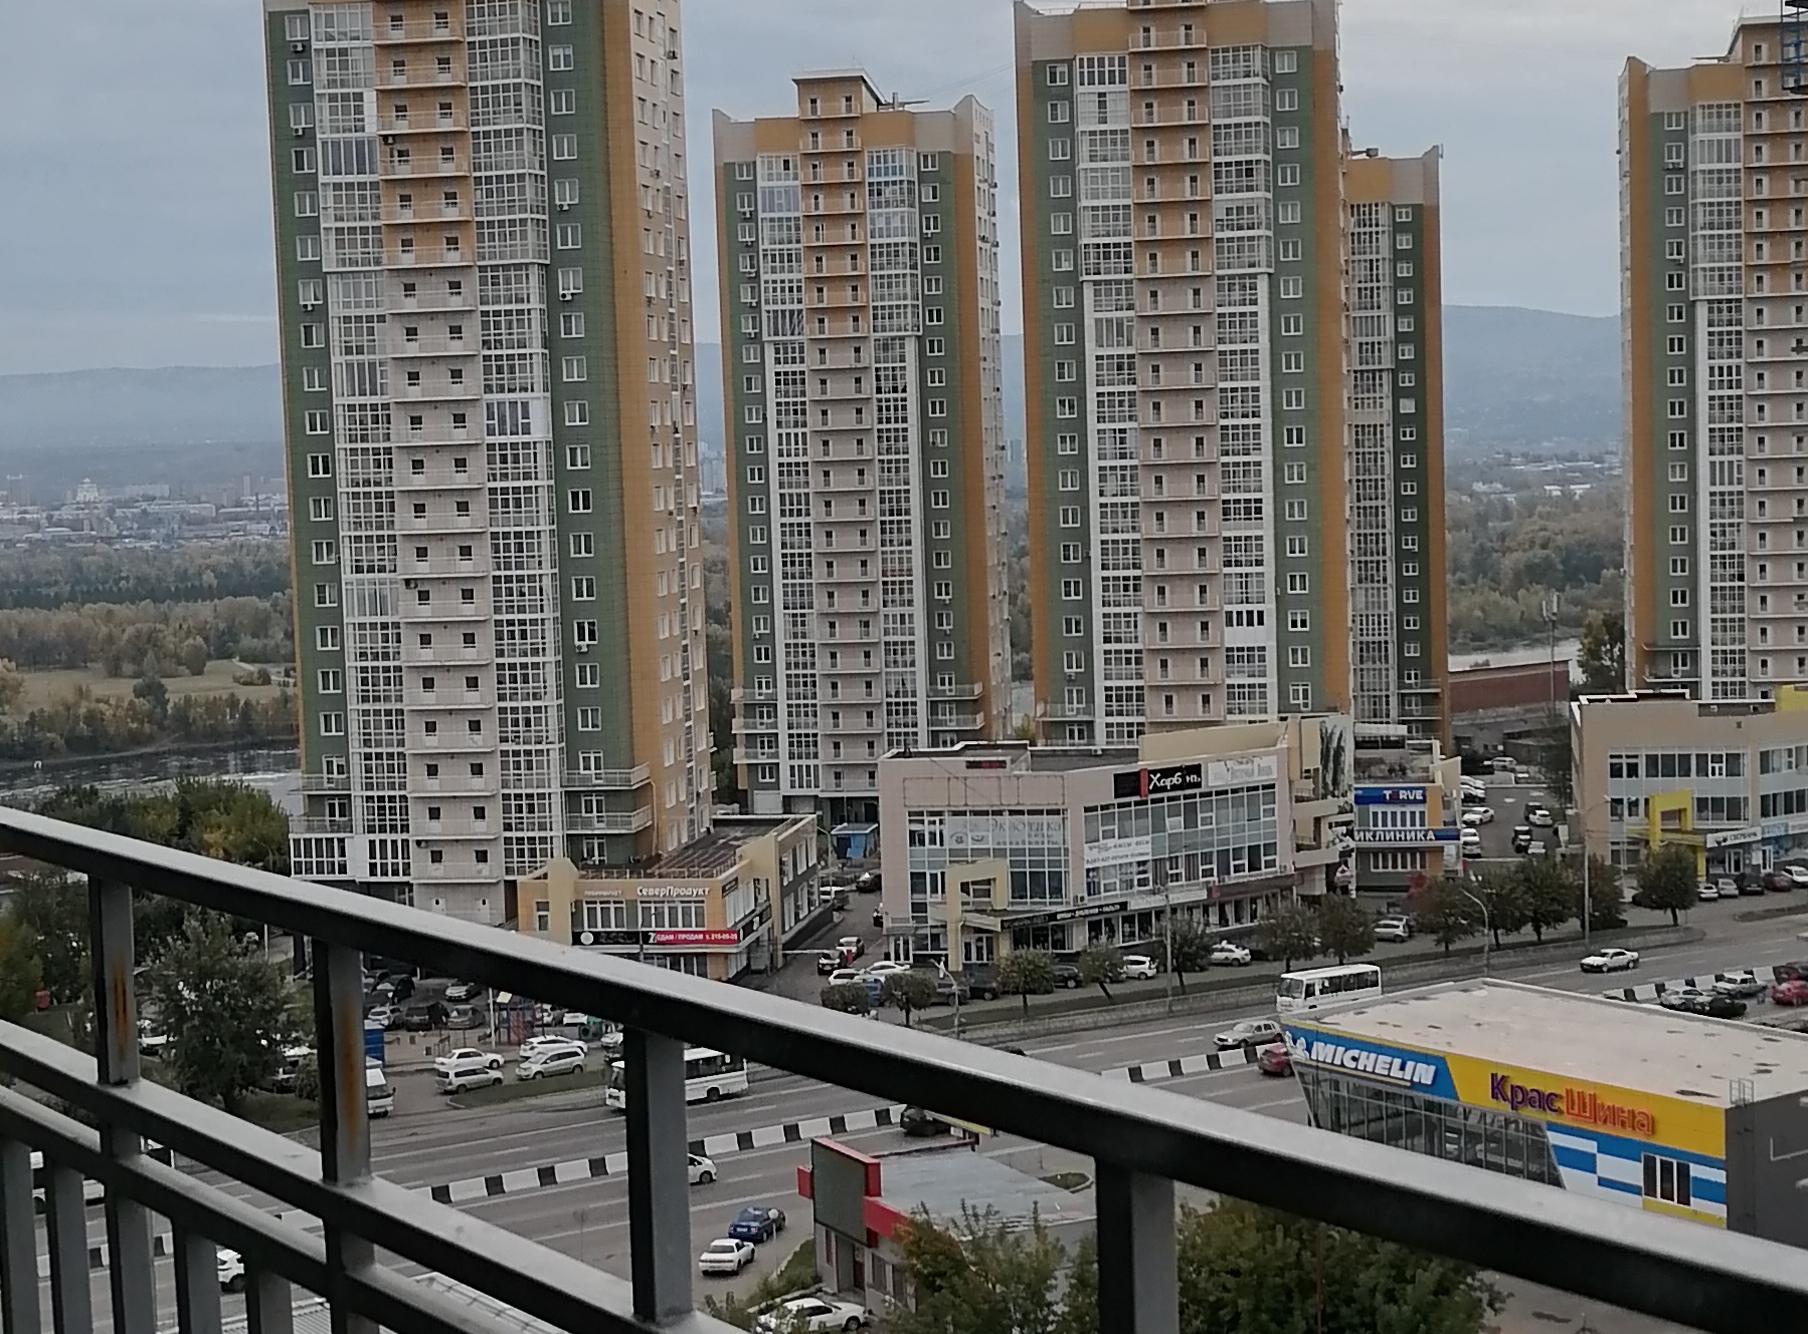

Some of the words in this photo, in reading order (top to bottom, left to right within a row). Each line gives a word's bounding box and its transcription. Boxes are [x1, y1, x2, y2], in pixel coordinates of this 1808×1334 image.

[1355, 830, 1436, 841] ИКЛИНИКА
[637, 886, 709, 896] СеверПродукт
[1310, 1041, 1436, 1085] MICHELIN
